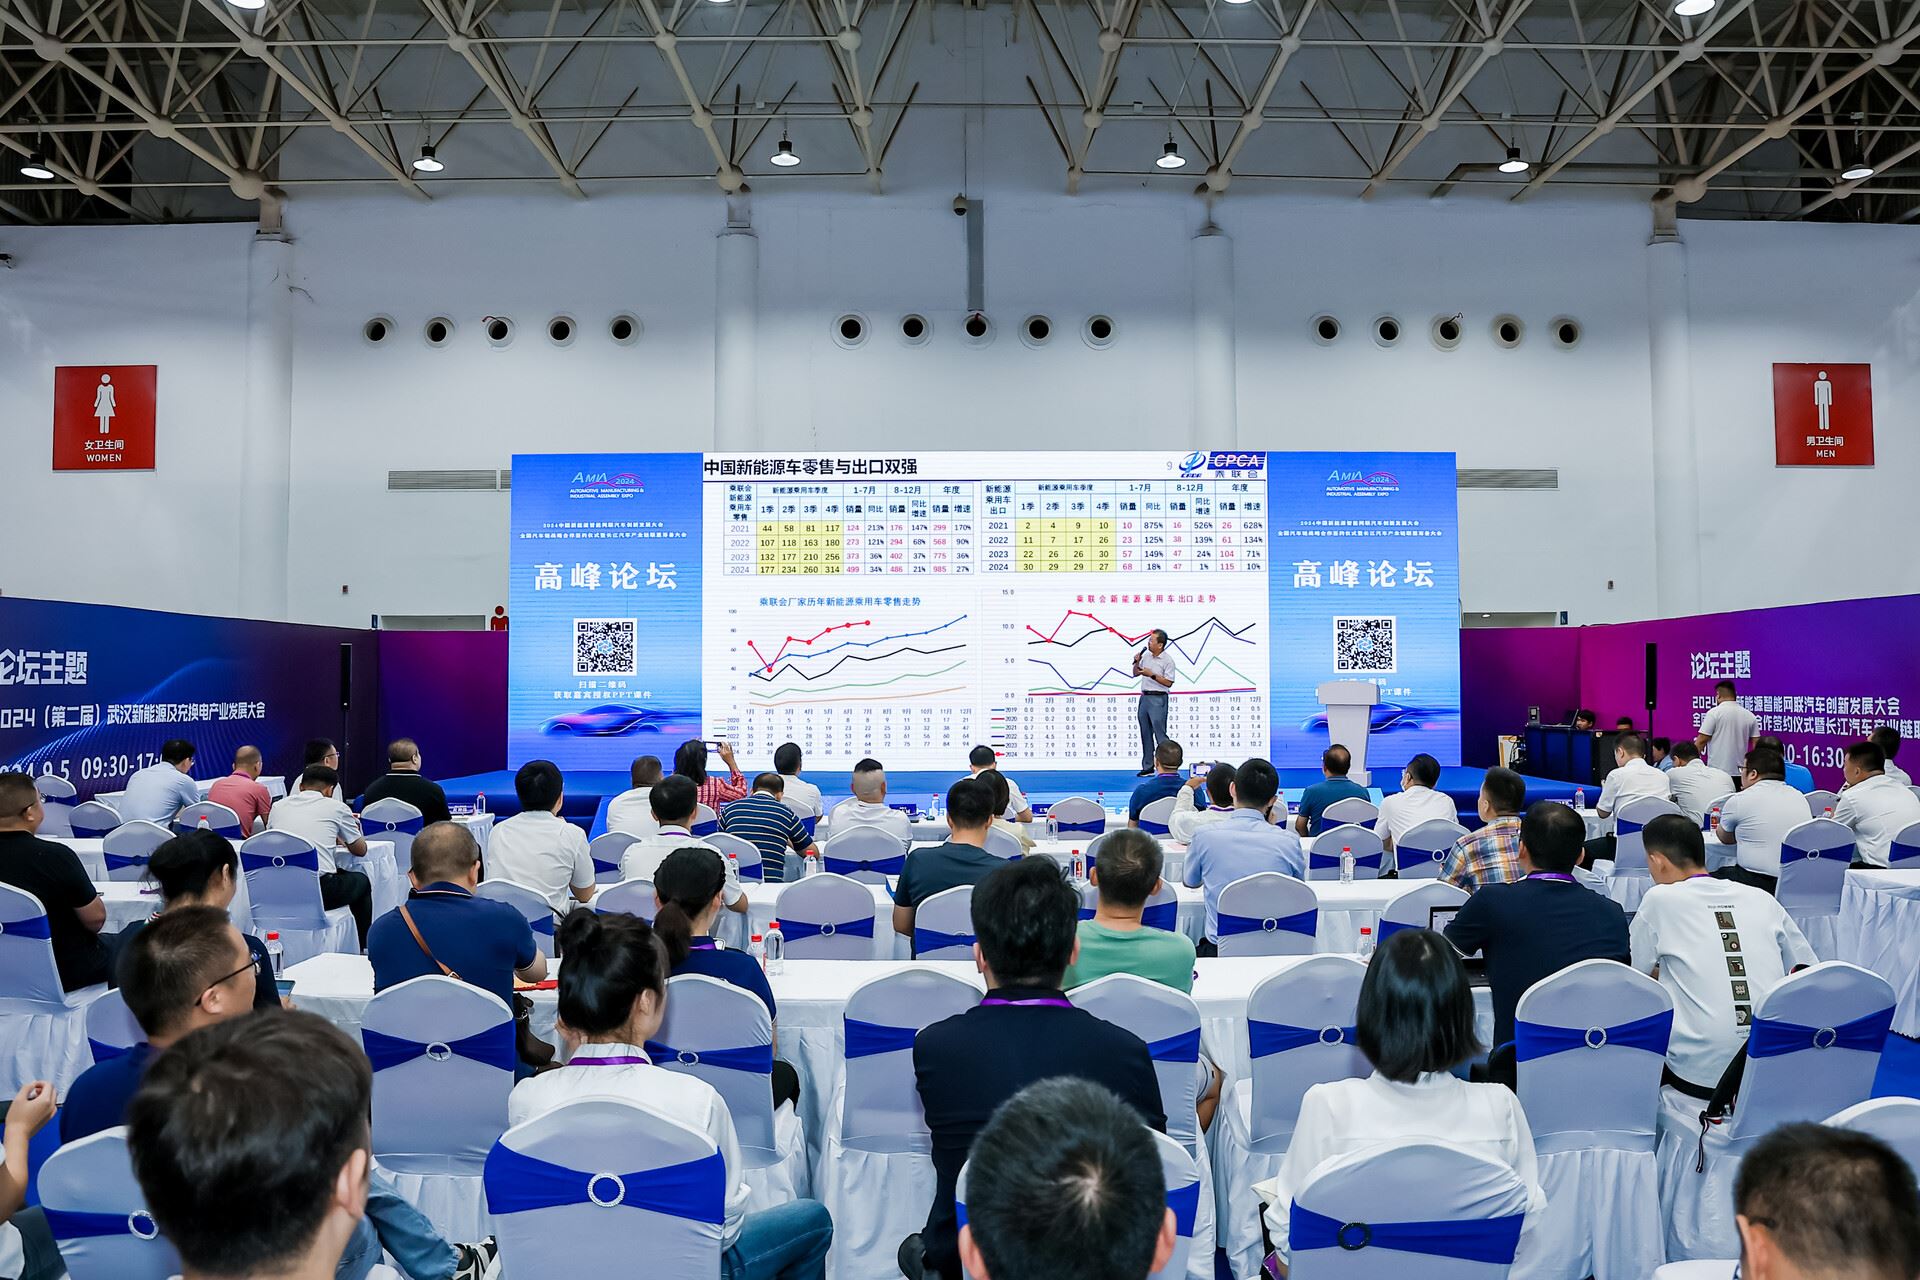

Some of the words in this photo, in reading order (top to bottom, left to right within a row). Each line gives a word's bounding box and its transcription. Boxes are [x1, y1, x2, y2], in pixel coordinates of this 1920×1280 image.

[84, 440, 124, 450] 女卫生间
[1806, 436, 1844, 446] 男卫生间
[1166, 461, 1172, 470] 9
[1214, 455, 1259, 467] CPCA
[704, 458, 918, 476] 中国新能源车零售与出口双强
[854, 486, 876, 494] 1-7月
[894, 486, 921, 494] 8-12月
[943, 486, 960, 494] 年度
[1130, 484, 1151, 492] 1-7月
[1176, 484, 1204, 492] 8-12月
[1232, 484, 1248, 492] 年度
[761, 505, 774, 513] 1季
[782, 505, 795, 513] 2季
[804, 505, 817, 513] 3季
[826, 505, 839, 513] 4季
[846, 505, 862, 513] 销量
[868, 505, 883, 513] 同比
[889, 505, 906, 513] 销量
[932, 505, 949, 513] 销量
[954, 505, 971, 513] 增速
[1021, 502, 1035, 511] 1季
[1046, 502, 1060, 511] 2季
[1071, 502, 1085, 511] 3季
[1096, 502, 1110, 511] 4季
[1120, 502, 1136, 511] 销量
[1146, 502, 1161, 510] 同比
[1170, 502, 1186, 511] 销量
[1220, 502, 1236, 511] 销量
[1244, 502, 1261, 511] 增速
[731, 525, 749, 533] 2021
[534, 562, 677, 590] 高峰论坛
[1292, 559, 1434, 588] 高峰论坛
[0, 648, 87, 685] 论坛主题
[1691, 650, 1750, 679] 论坛主题
[1692, 695, 1900, 716] 2024新能源智能网联汽车创新发展大会
